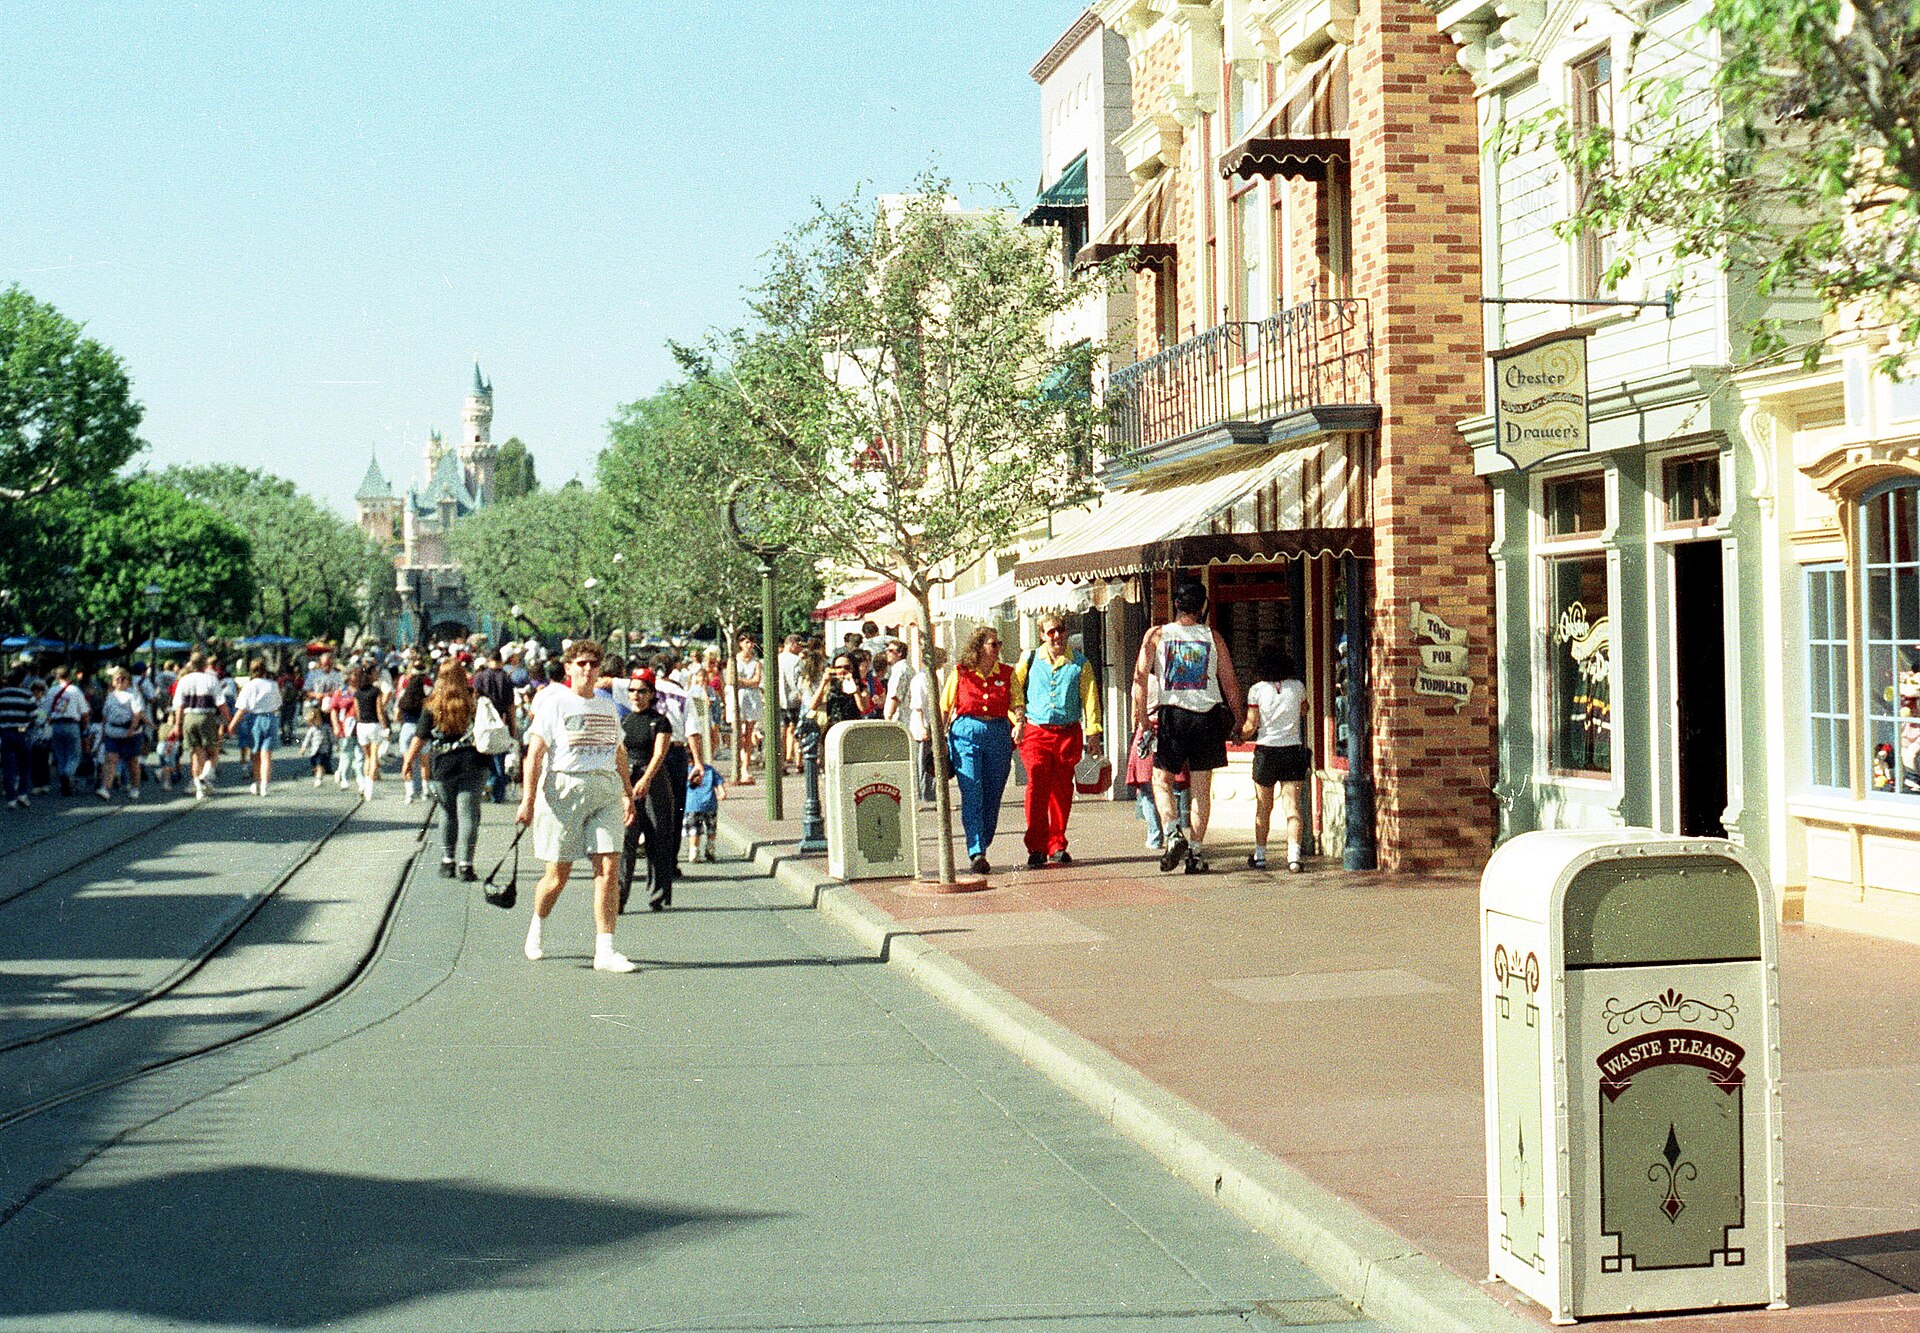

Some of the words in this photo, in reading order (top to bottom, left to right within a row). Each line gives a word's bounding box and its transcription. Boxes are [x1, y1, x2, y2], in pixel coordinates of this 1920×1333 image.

[1505, 365, 1565, 389] Chester
[1432, 651, 1451, 663] FOR
[1420, 677, 1468, 695] TODDLERS
[1603, 1039, 1663, 1076] WASTE
[1668, 1038, 1736, 1069] PLEASE
